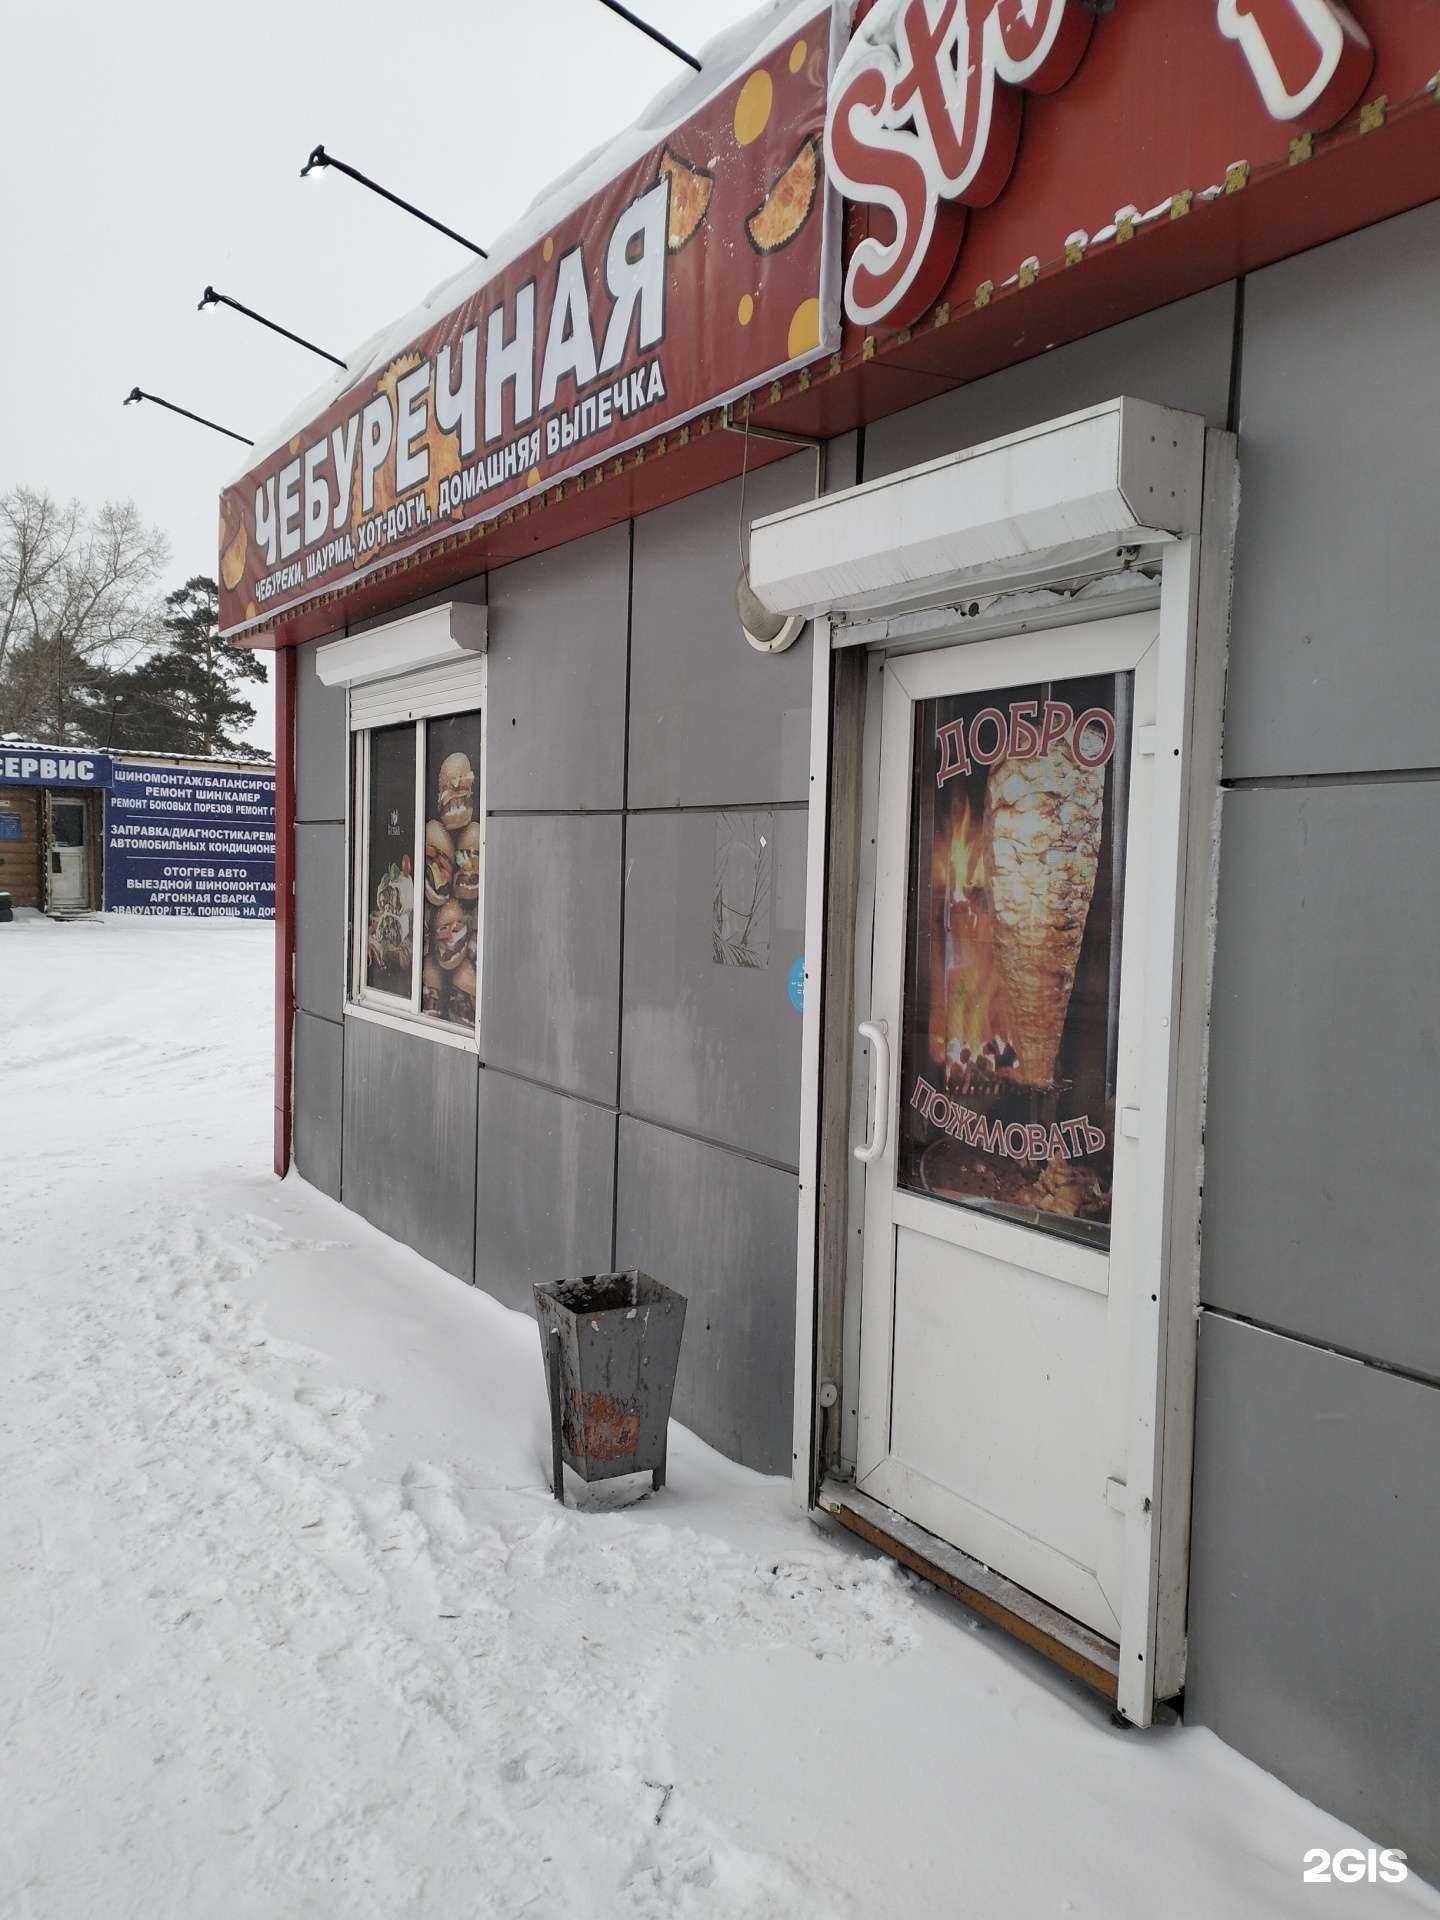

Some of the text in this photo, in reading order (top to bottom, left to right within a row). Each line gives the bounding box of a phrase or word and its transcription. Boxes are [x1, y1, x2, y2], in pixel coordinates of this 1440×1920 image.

[255, 176, 669, 566] ЧЕБУРЕЧНАЯ
[306, 534, 356, 579] ШАУРМА,
[357, 492, 432, 554] ХОТ-ДОГИ,
[438, 428, 541, 519] ДОМАШНЯЯ
[546, 359, 666, 456] ВЫПЕЧКА
[936, 700, 1116, 788] ДОБРО
[0, 757, 94, 780] ЕРВИС
[145, 786, 260, 803] РЕМОНТ ШИН/КАМЕР
[111, 797, 147, 809] РЕМОНТ
[150, 800, 192, 812] БОКОВЫХ
[236, 805, 267, 816] РЕМОНТ
[111, 824, 276, 841] ЗАПРАВКА/ДИАГНОСТИКА/РЕМ
[110, 838, 206, 852] АВТОМОБИЛЬНЫХ
[163, 866, 247, 878] ОТОГРЕВ АВТО
[126, 878, 276, 891] ВЫЕЗДНОЙ ШИНОМОНТАЖ
[149, 893, 257, 904] АРГОННАЯ СВАРКА
[175, 906, 196, 916] ТЕХ.
[198, 906, 241, 917] ПОМОЩЬ
[243, 907, 256, 917] НА
[909, 1077, 1106, 1162] ПОЖАЛОВАТЬ
